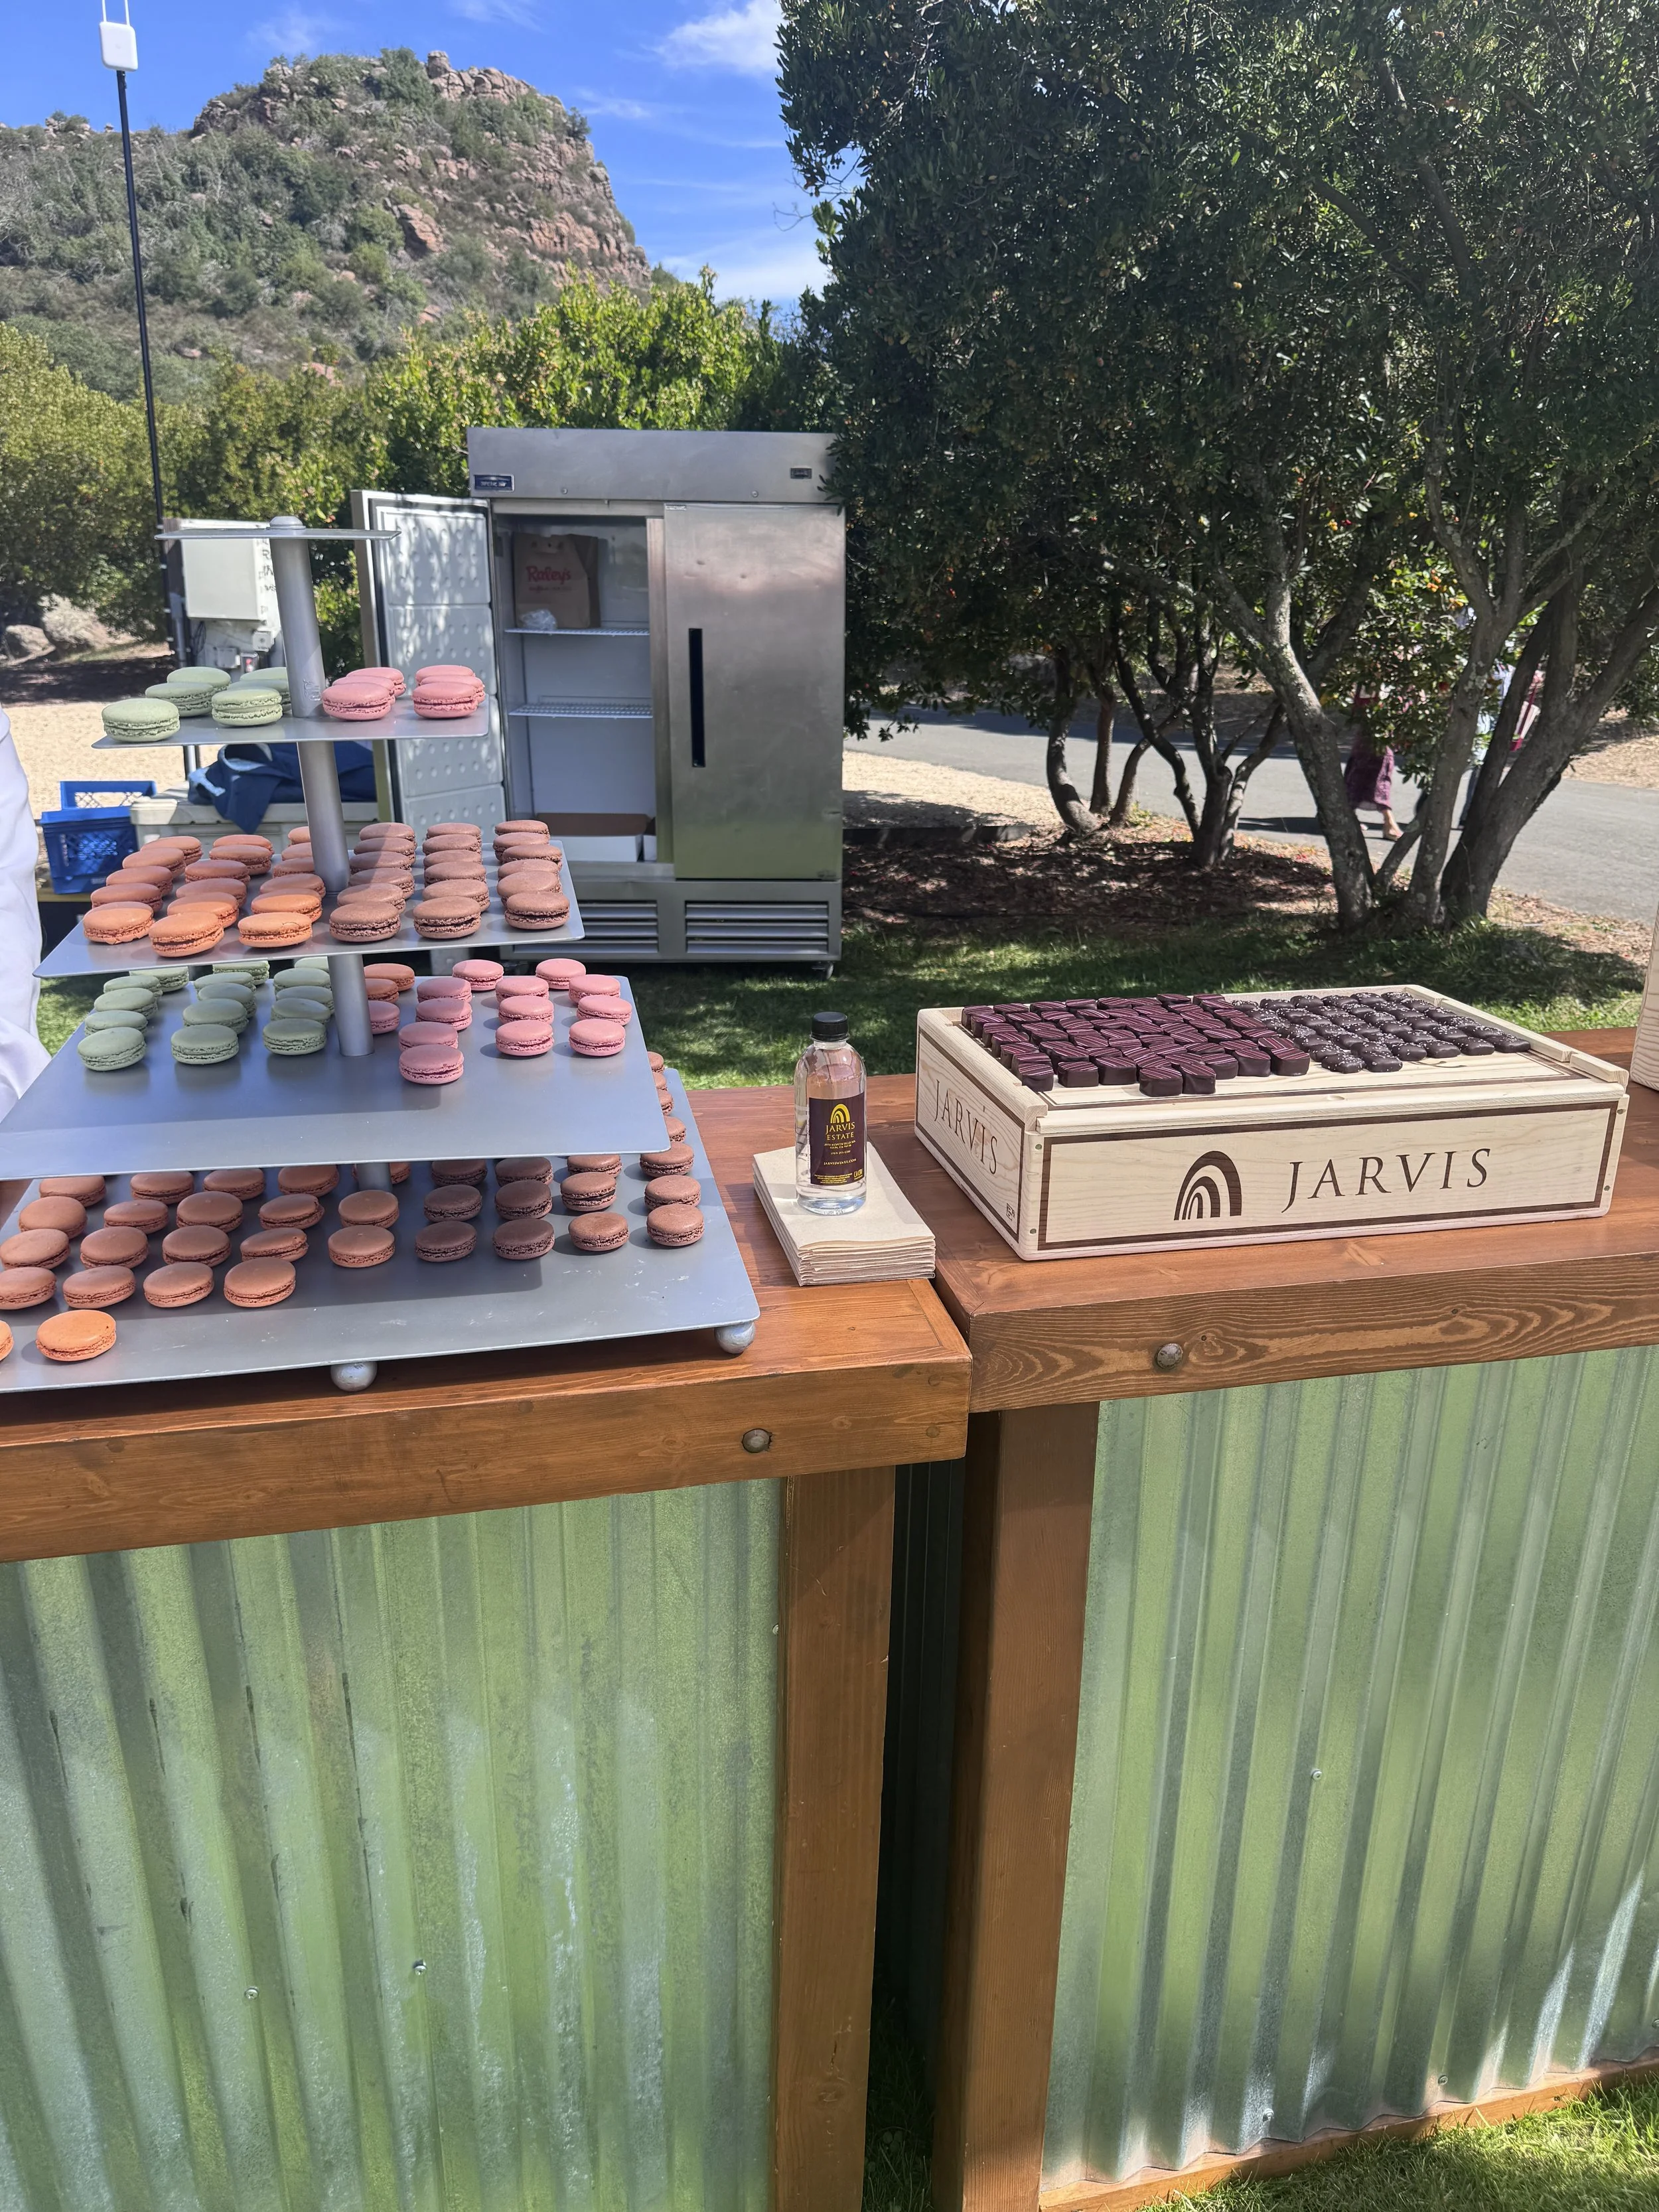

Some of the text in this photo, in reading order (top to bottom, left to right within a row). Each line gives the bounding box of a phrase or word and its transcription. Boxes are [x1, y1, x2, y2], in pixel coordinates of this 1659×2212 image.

[526, 565, 571, 585] Raley's
[826, 1122, 855, 1134] JARVIS
[827, 1132, 854, 1141] ESTATE
[934, 1079, 997, 1174] JARVIS
[1281, 1148, 1490, 1213] JARVIS
